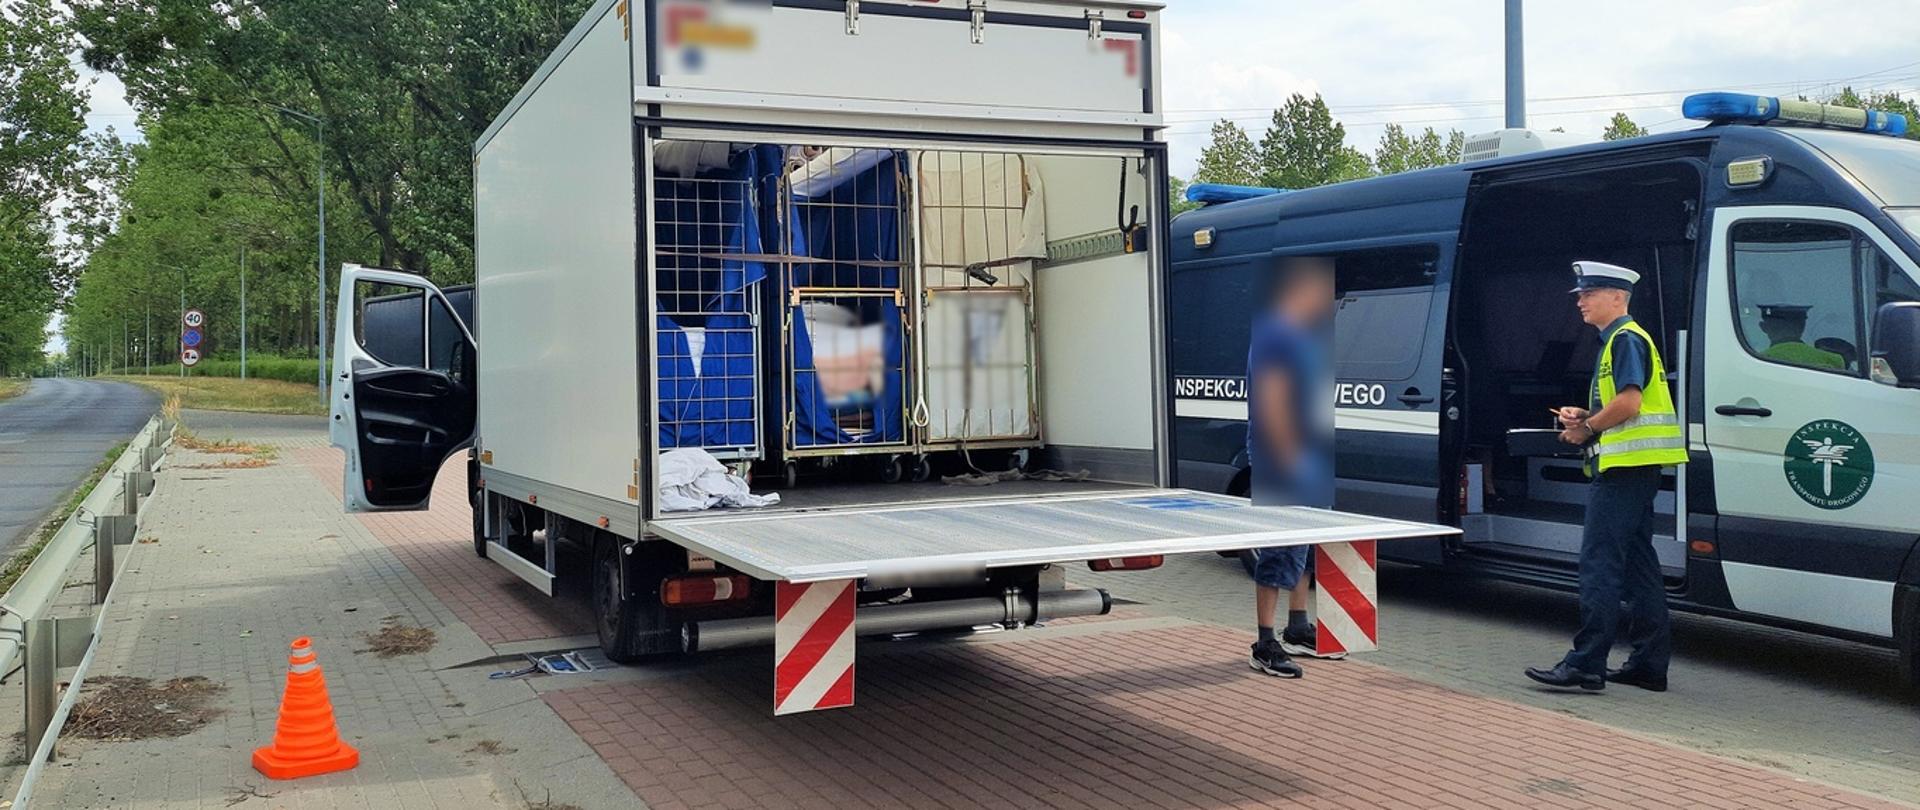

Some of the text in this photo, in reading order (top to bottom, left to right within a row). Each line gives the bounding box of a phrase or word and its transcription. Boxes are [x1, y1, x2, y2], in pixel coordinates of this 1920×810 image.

[187, 314, 200, 324] 40
[1176, 379, 1386, 405] NSPEKCJ EGO
[1796, 422, 1859, 443] INSPEKCJA
